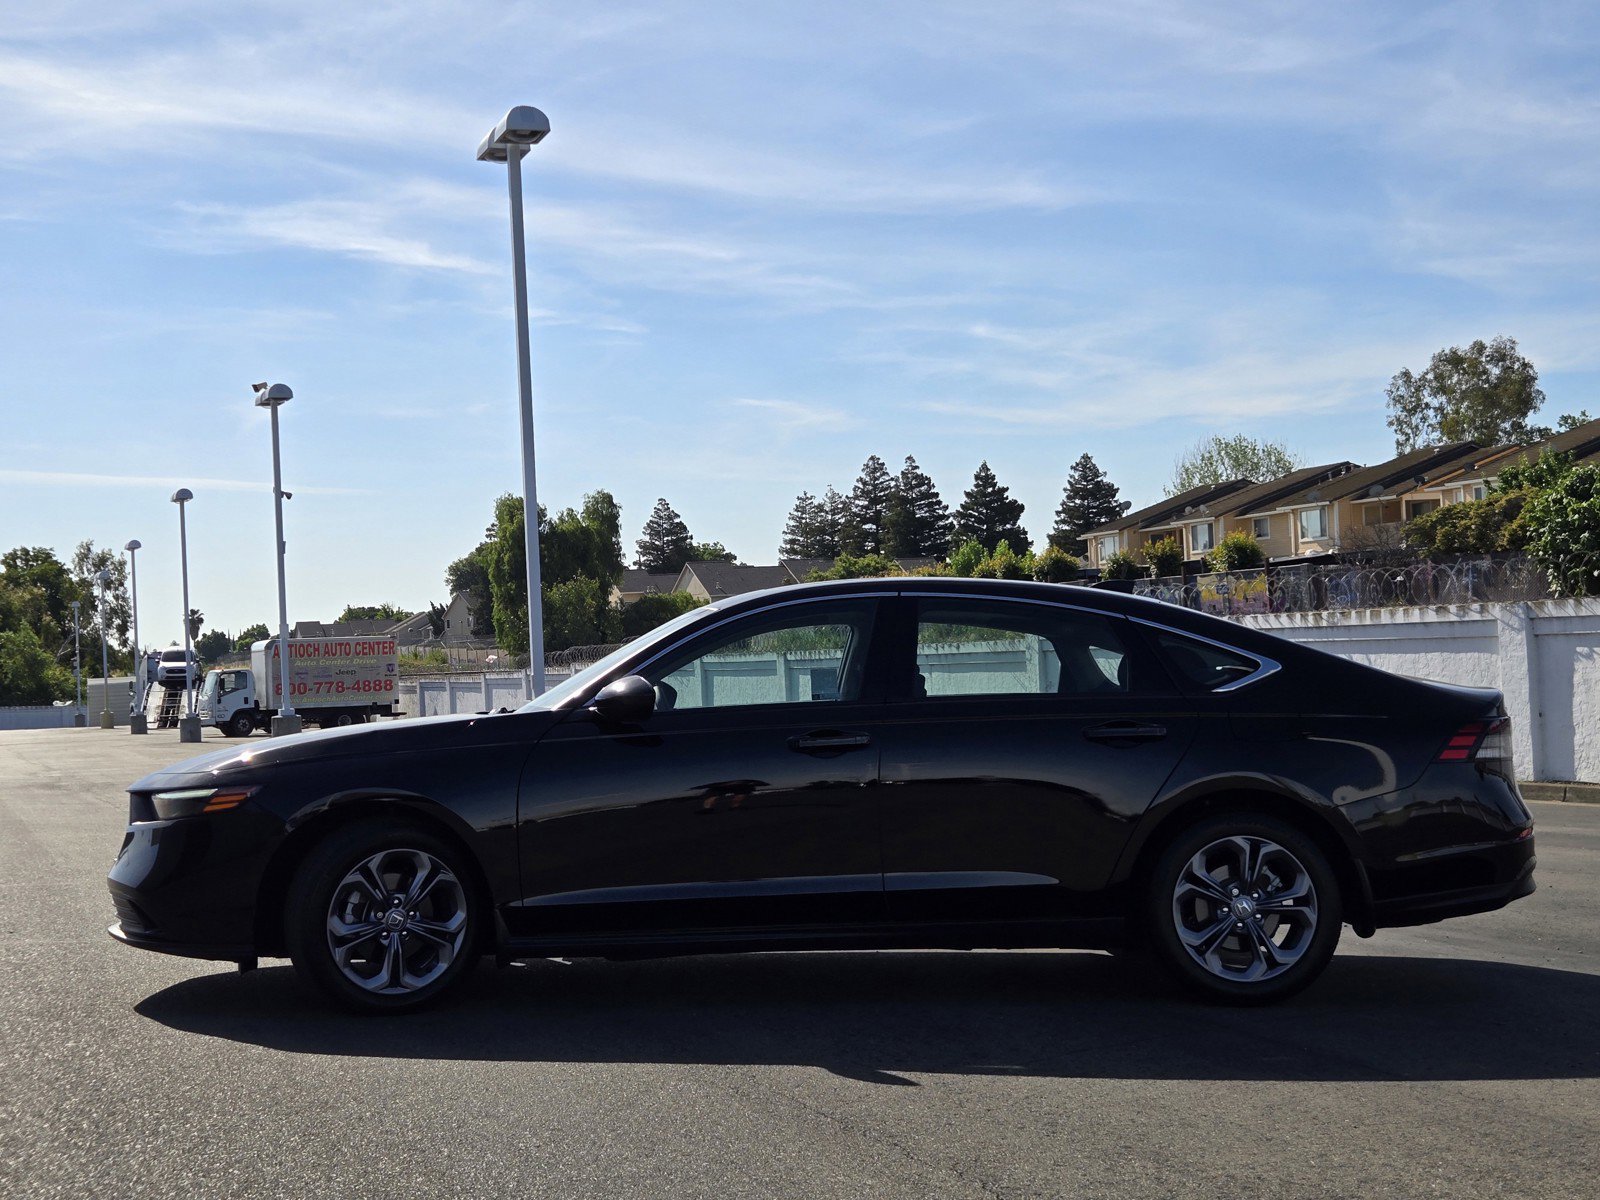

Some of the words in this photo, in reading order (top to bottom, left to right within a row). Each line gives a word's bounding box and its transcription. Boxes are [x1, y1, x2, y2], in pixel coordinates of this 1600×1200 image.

[272, 643, 320, 659] ATIOCH
[323, 642, 352, 658] AUTO
[354, 641, 396, 656] CENTER
[275, 679, 393, 696] 800-778-4888
